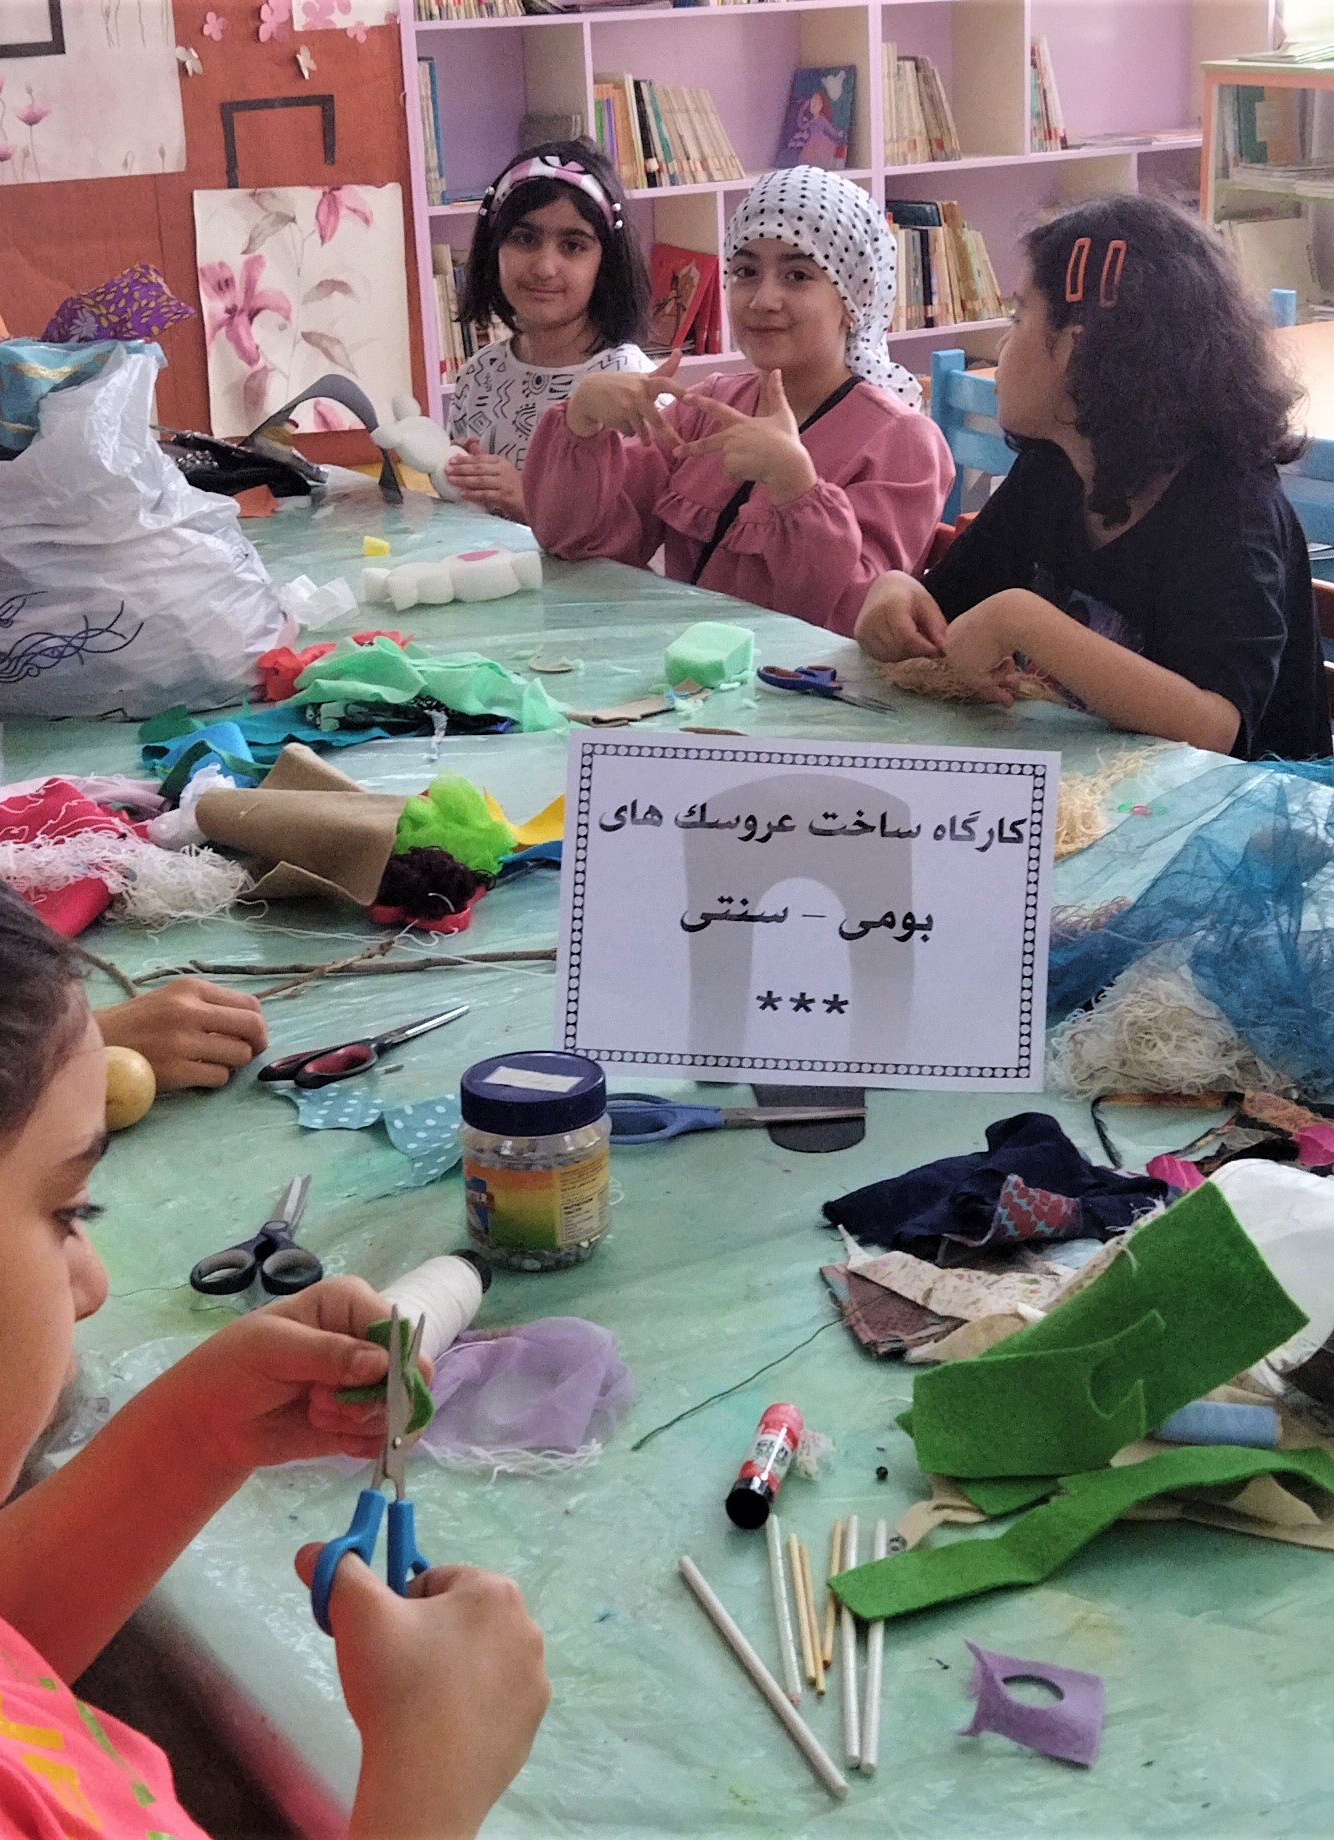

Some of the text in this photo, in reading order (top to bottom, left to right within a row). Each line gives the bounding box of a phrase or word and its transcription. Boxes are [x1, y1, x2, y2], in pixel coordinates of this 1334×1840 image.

[598, 799, 663, 832] های
[808, 806, 922, 839] ساخت
[933, 809, 1027, 853] کارگاه
[680, 896, 788, 932] سنتی
[838, 907, 933, 942] بومی
